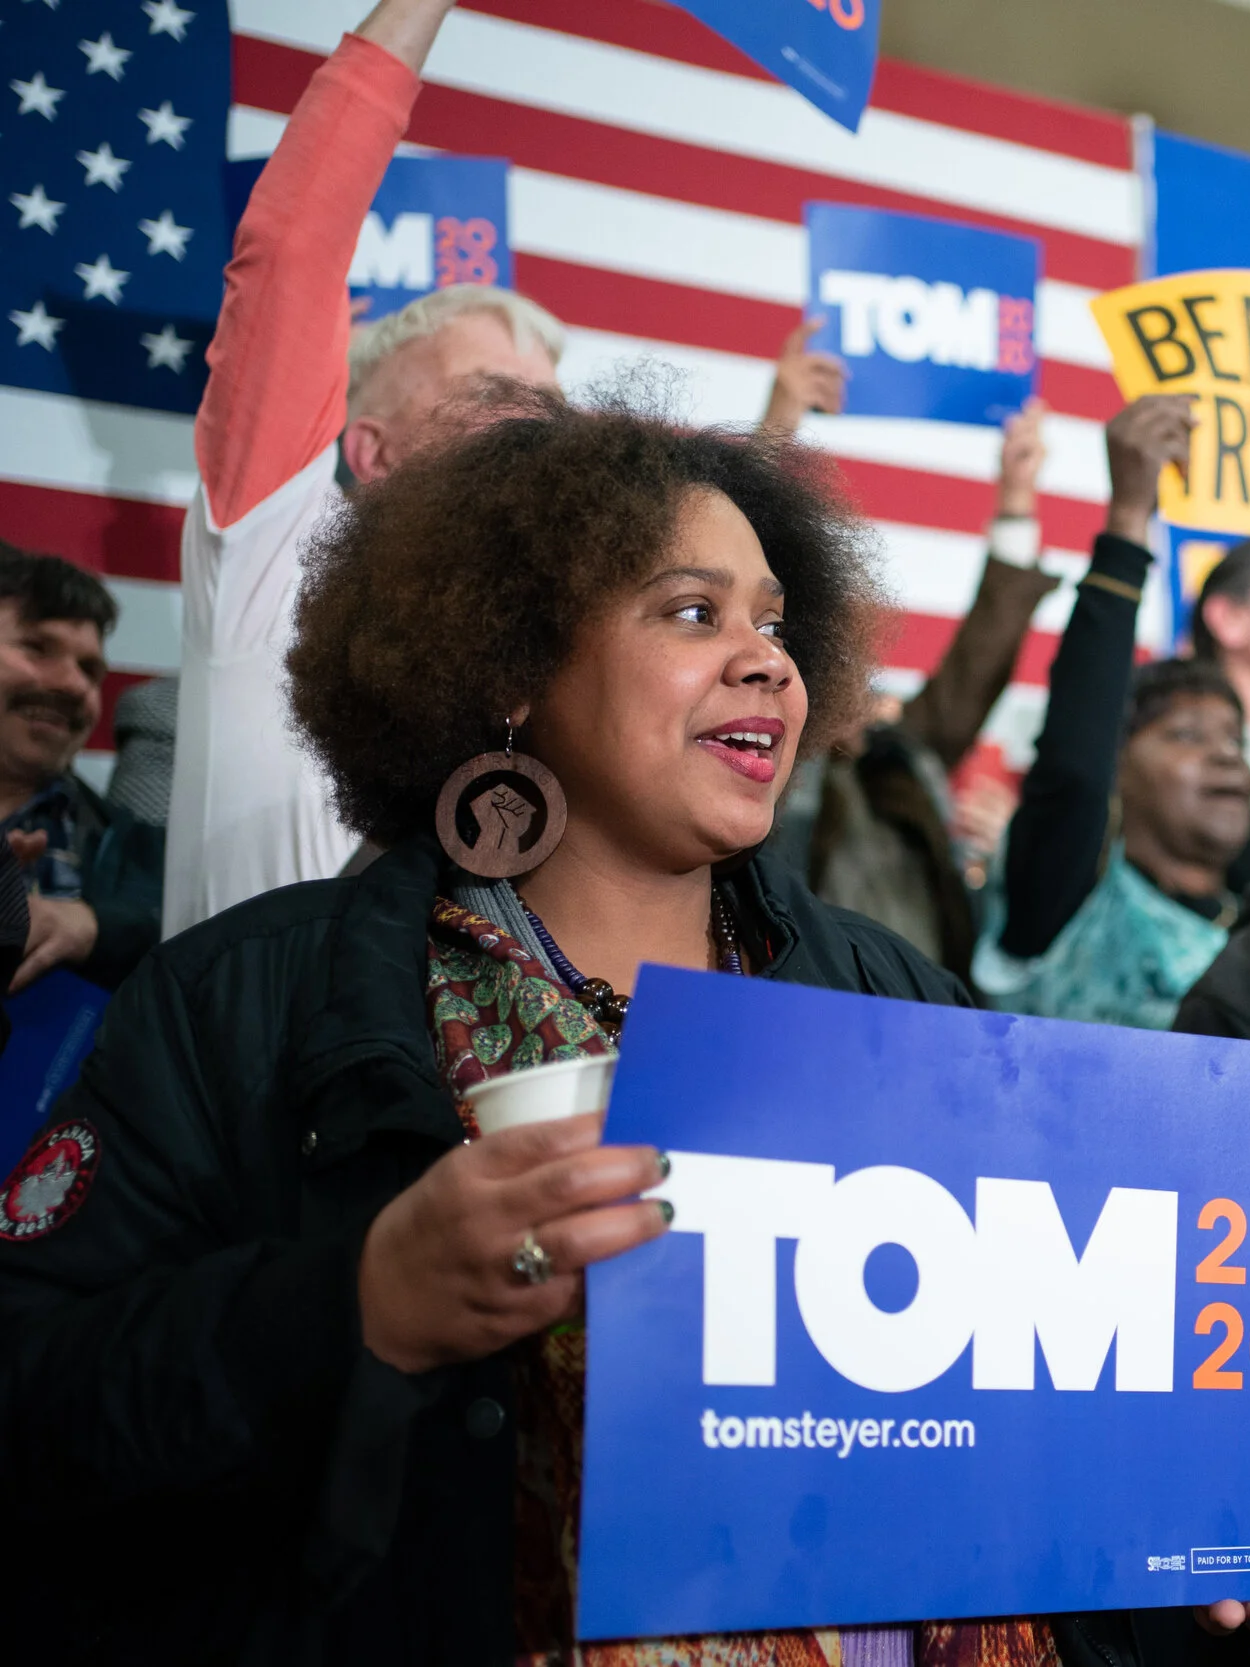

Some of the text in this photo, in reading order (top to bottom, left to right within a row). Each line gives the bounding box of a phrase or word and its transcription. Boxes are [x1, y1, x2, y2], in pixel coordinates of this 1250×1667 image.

[819, 269, 1000, 373] TOM
[48, 1125, 95, 1163] CANADA
[642, 1150, 1179, 1394] TOM
[701, 1408, 976, 1459] tomsteyer.com
[1198, 1556, 1214, 1565] PAID
[1216, 1555, 1231, 1564] FOR
[1233, 1555, 1242, 1563] BY
